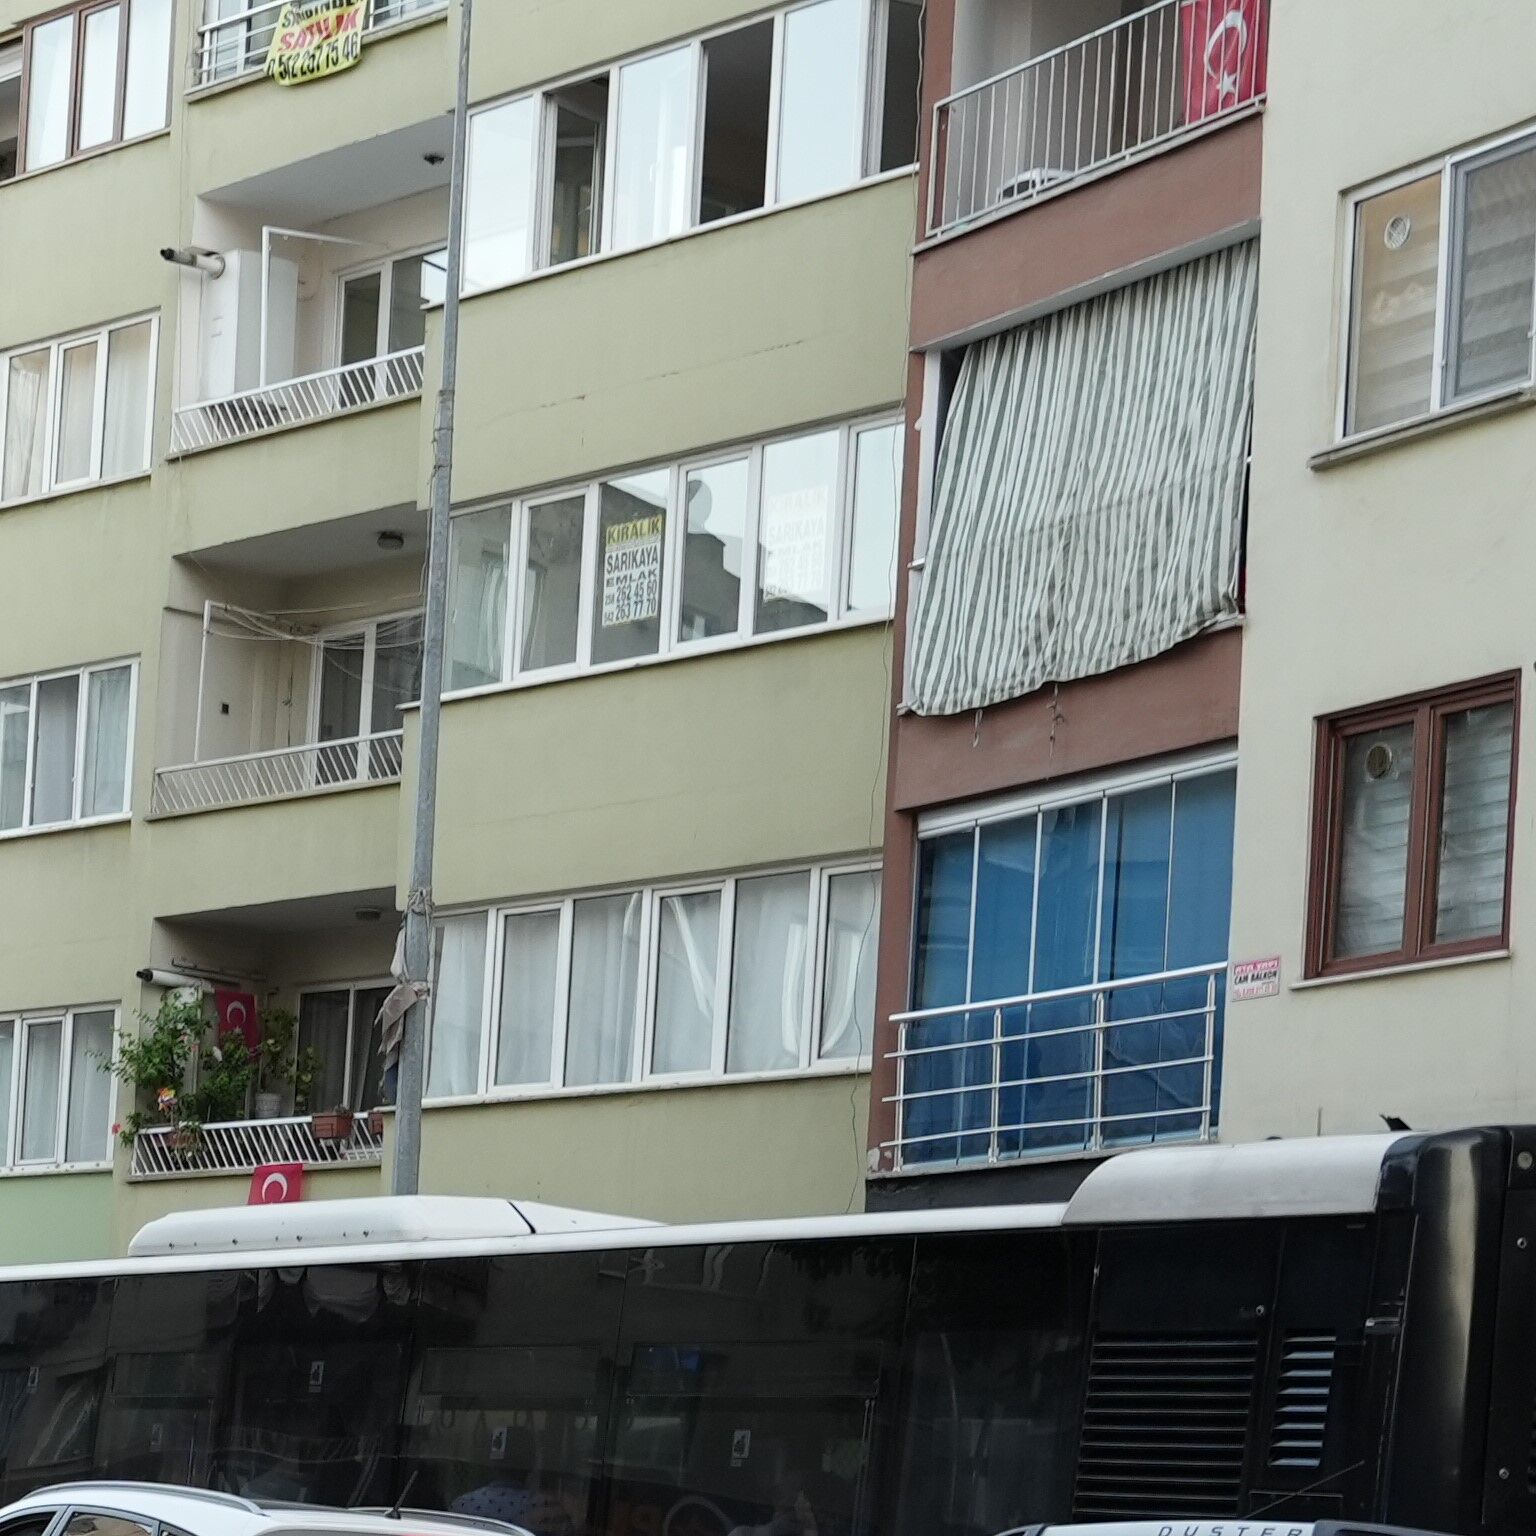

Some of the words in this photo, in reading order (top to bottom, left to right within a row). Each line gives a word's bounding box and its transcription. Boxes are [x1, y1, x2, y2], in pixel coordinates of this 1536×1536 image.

[607, 518, 660, 545] KIRALIK
[607, 545, 658, 574] SARIKAYA
[606, 568, 657, 588] EMLAK
